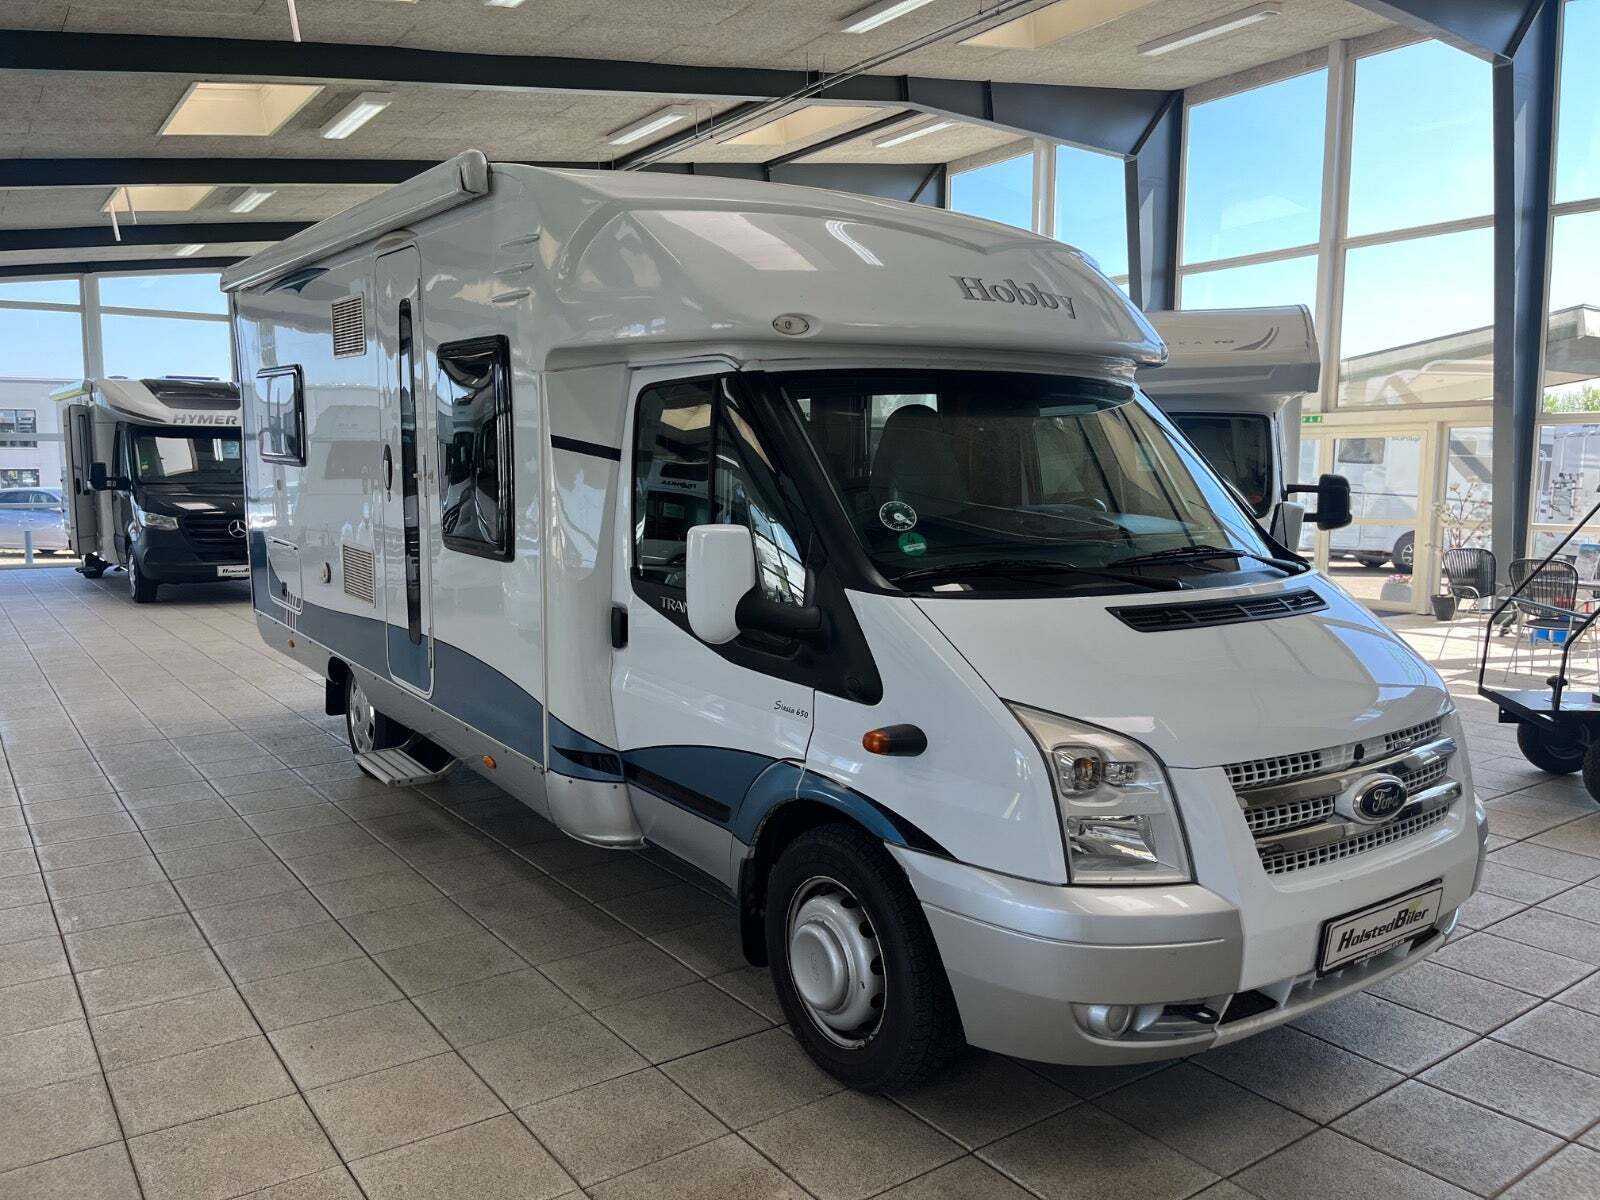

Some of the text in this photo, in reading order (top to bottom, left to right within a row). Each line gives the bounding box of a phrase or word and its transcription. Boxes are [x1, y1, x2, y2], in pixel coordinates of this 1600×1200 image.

[948, 274, 1077, 320] Hobby
[172, 413, 238, 425] HYMER
[795, 708, 809, 719] 650
[1371, 785, 1400, 813] Ford
[1336, 907, 1430, 953] HolstedBiler
